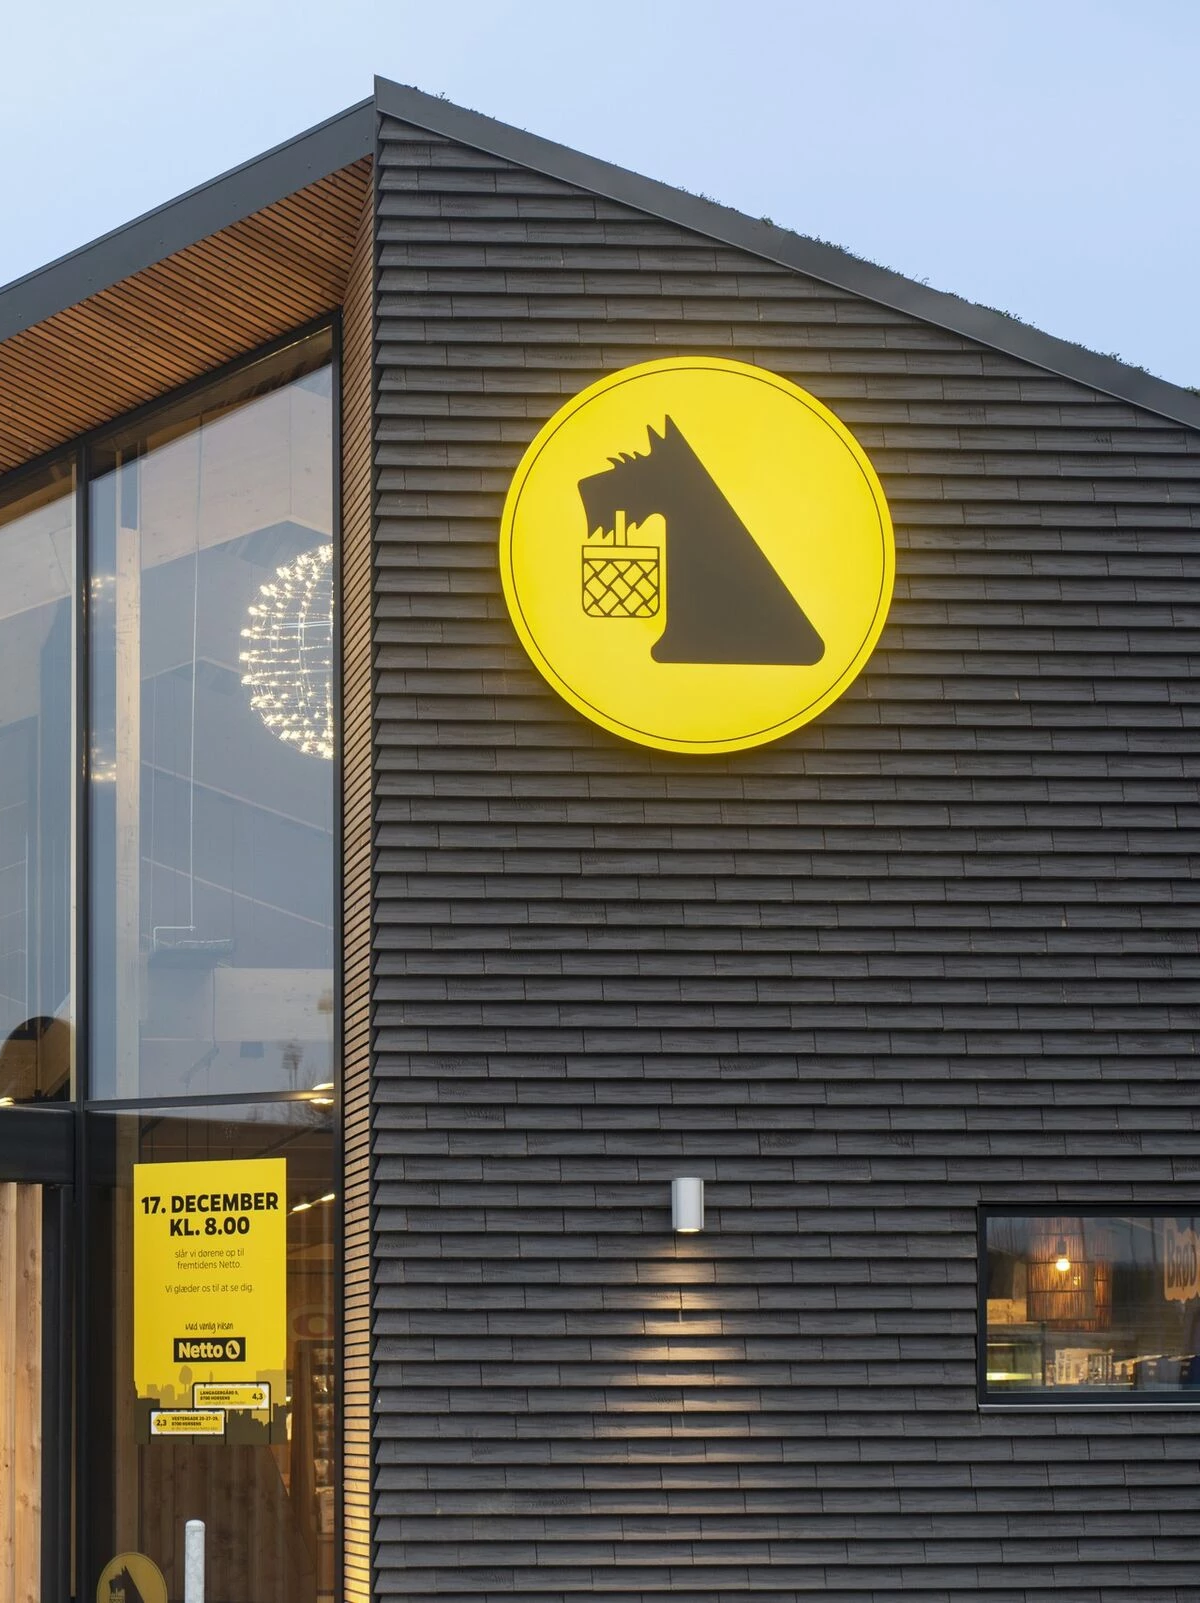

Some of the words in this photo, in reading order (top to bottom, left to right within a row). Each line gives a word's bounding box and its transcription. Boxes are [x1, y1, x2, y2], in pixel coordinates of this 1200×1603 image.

[141, 1196, 166, 1214] 17.
[171, 1192, 279, 1213] DECEMBER
[170, 1218, 200, 1236] KL.
[204, 1216, 250, 1236] 8.00
[174, 1249, 188, 1258] slår
[189, 1249, 197, 1258] vi
[198, 1248, 224, 1258] dørene
[225, 1249, 236, 1258] op
[237, 1247, 245, 1257] til
[177, 1260, 217, 1270] fremtidens
[218, 1260, 241, 1269] Netto
[164, 1284, 173, 1293] Vi
[174, 1284, 199, 1294] glæder
[201, 1285, 211, 1293] os
[212, 1284, 220, 1293] til
[220, 1284, 229, 1292] at
[230, 1284, 239, 1292] se
[178, 1342, 223, 1359] Netto
[252, 1392, 264, 1401] 4,3
[156, 1419, 167, 1427] 2,3
